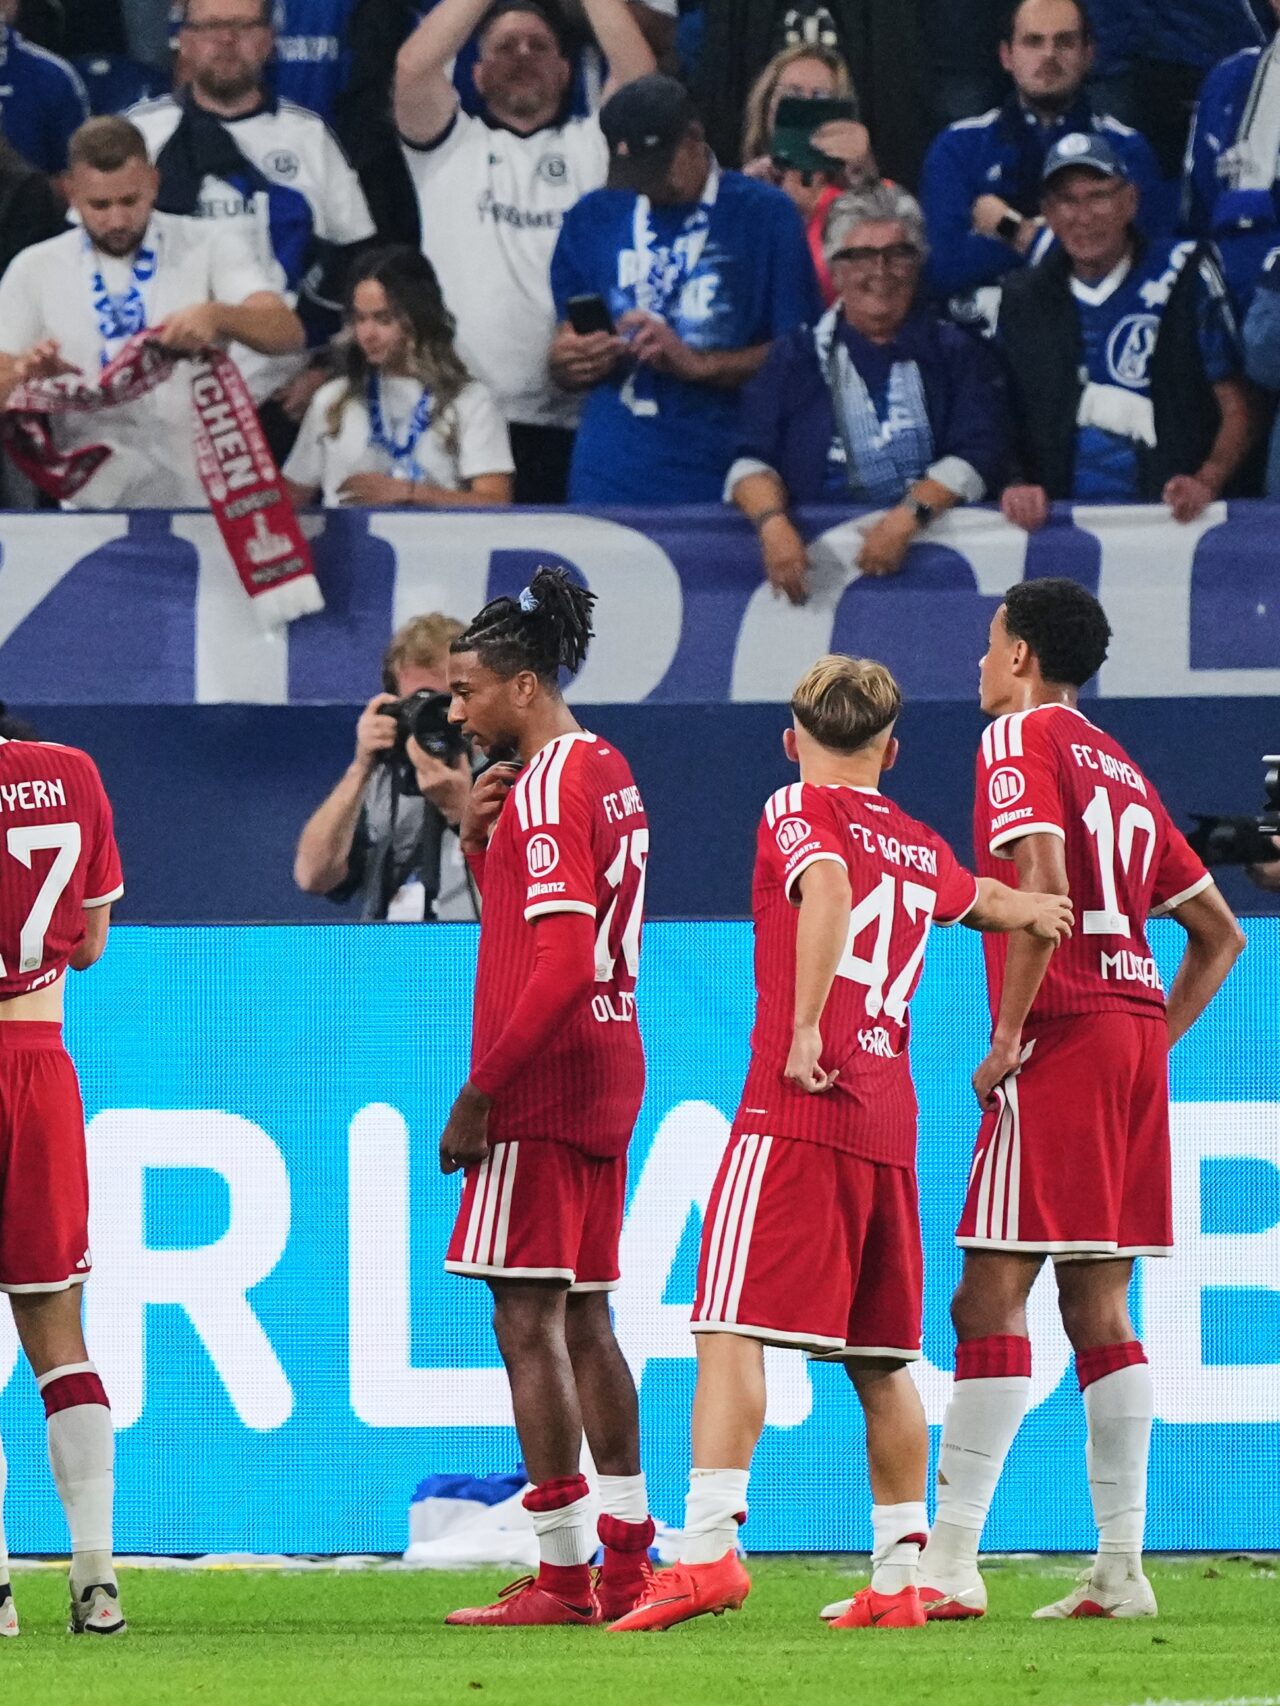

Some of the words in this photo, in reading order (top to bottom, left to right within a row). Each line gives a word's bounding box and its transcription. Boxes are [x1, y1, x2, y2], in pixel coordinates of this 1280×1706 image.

[1071, 743, 1099, 769] FC
[603, 789, 625, 824] FC
[991, 806, 1034, 833] Allianz
[848, 823, 876, 854] FC
[876, 833, 938, 877] BAYERN
[1082, 785, 1157, 939] 10
[526, 881, 566, 900] Allianz
[835, 871, 938, 1028] 47
